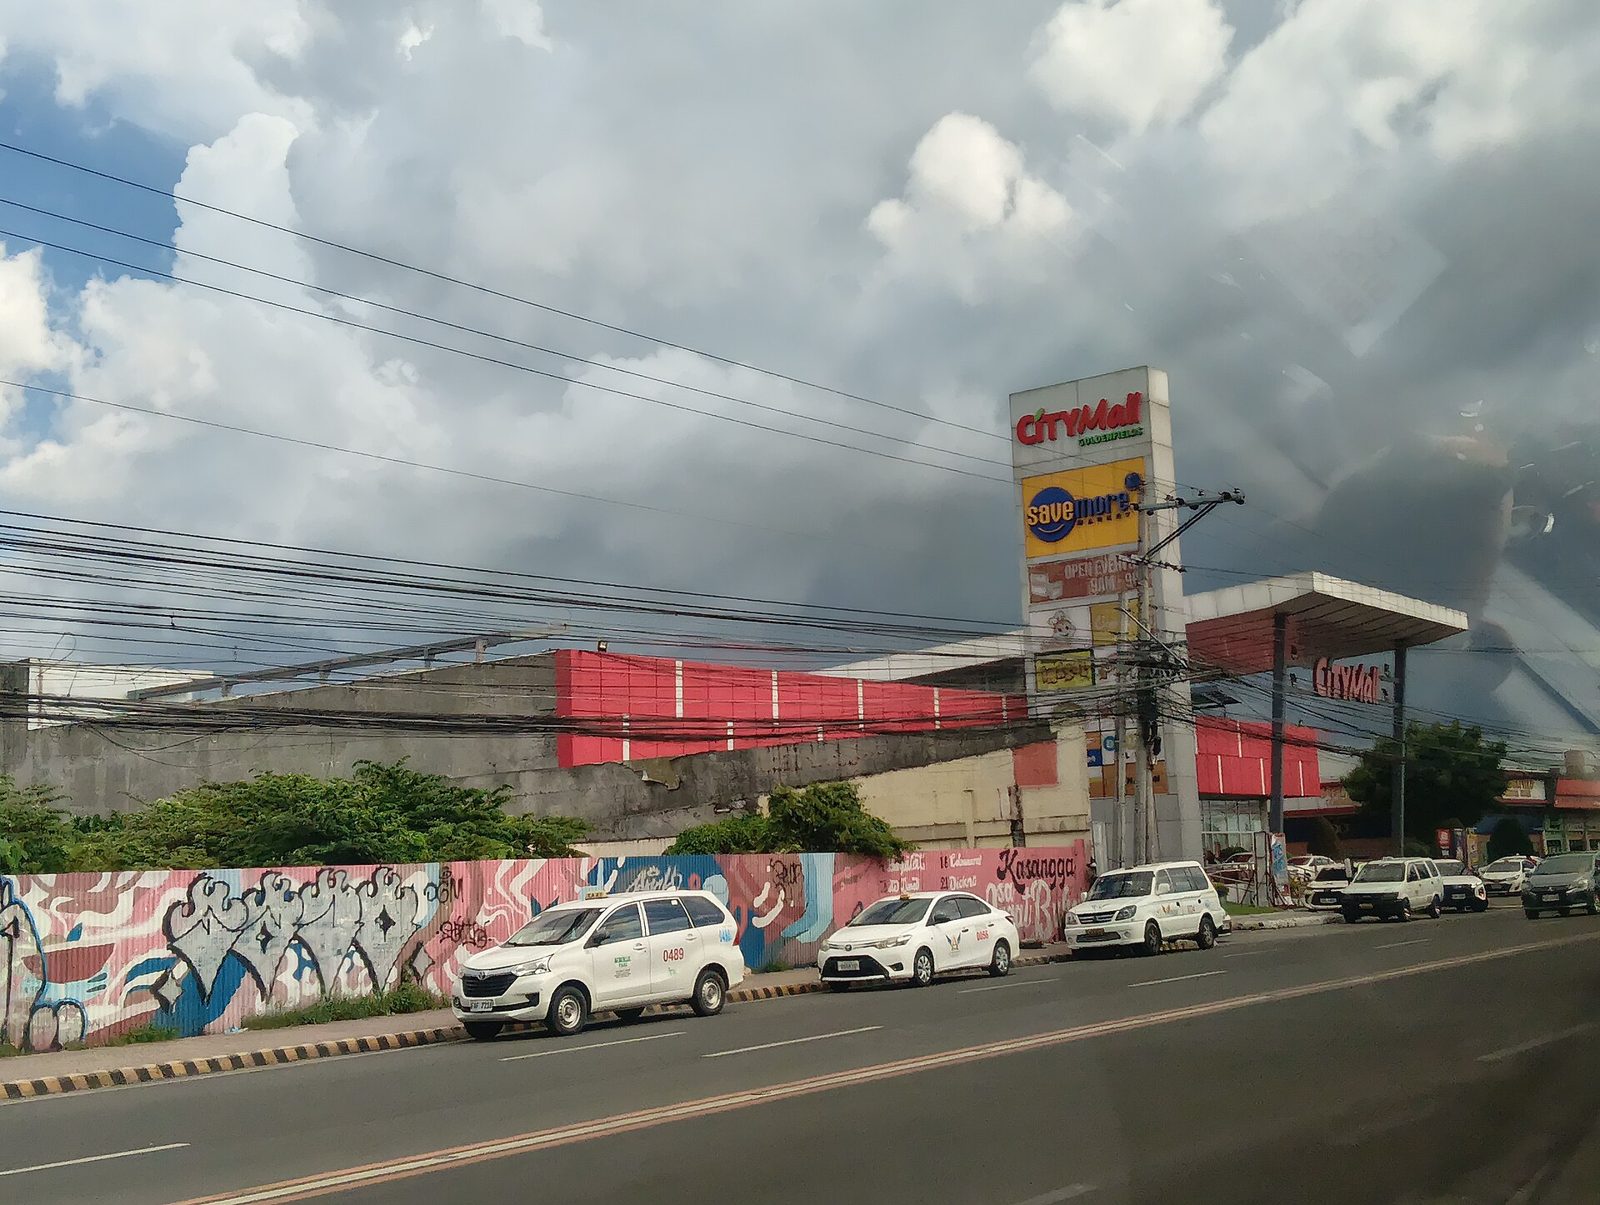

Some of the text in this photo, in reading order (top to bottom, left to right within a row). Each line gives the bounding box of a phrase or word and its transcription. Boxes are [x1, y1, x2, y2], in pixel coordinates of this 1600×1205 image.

[1064, 561, 1093, 579] OPEN
[996, 849, 1076, 896] Kasangga
[663, 948, 684, 962] 0489
